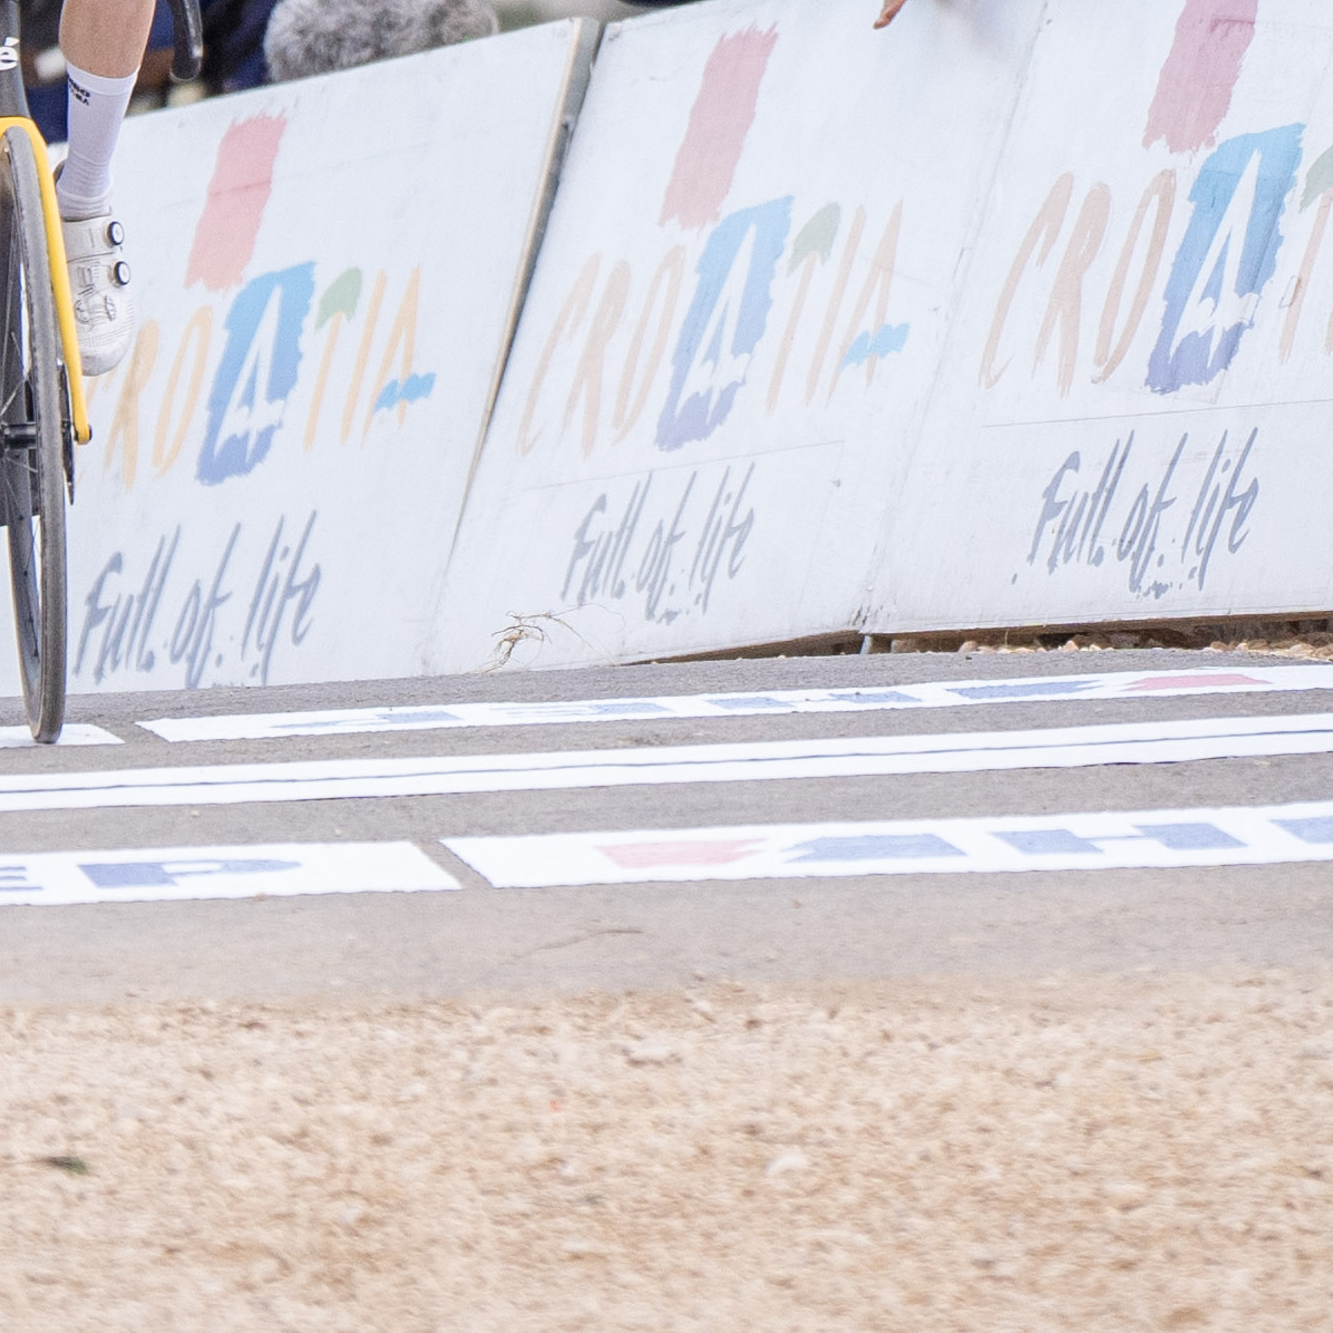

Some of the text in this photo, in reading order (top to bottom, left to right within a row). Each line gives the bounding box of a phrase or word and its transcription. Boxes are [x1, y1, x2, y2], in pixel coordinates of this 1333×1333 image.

[516, 196, 911, 457] CROATIA
[977, 121, 1333, 397] CROAT
[73, 509, 322, 689] Full of life
[559, 461, 757, 616] Full of life
[1025, 425, 1261, 593] Full of life
